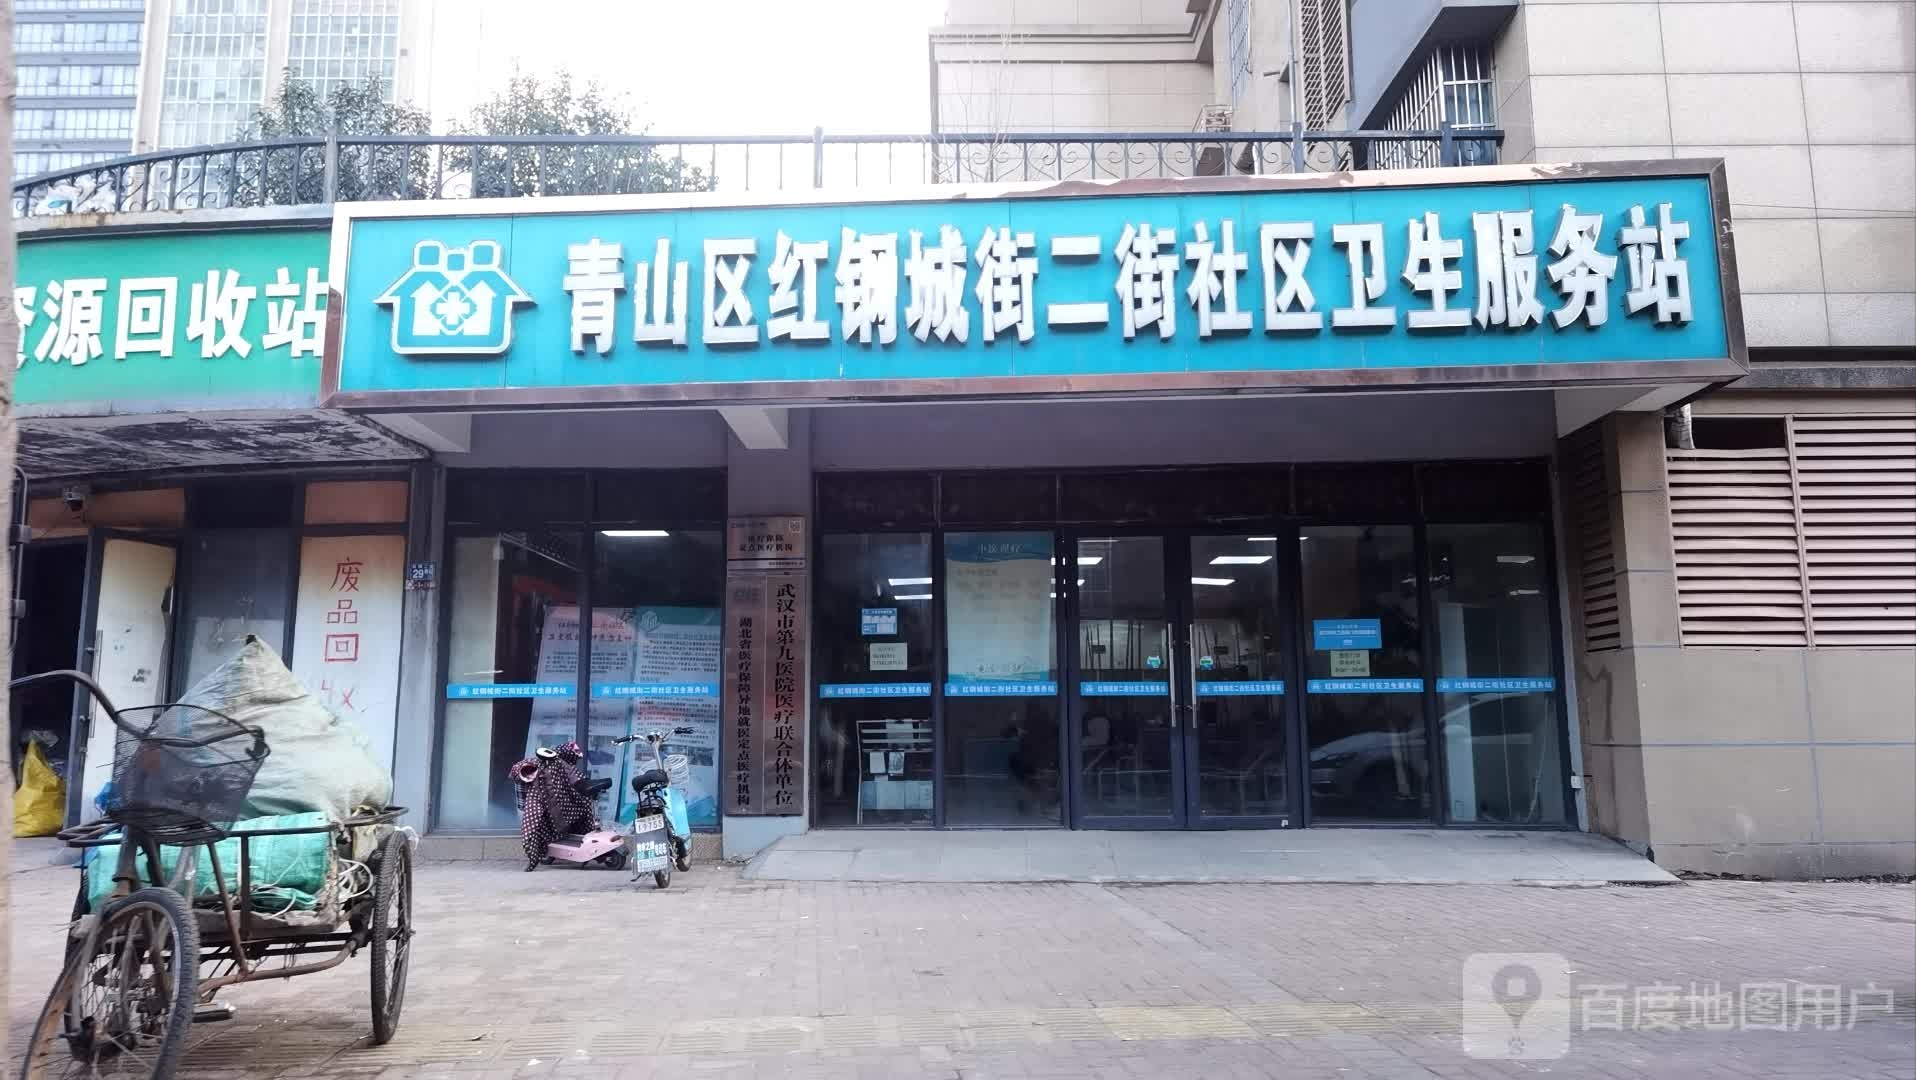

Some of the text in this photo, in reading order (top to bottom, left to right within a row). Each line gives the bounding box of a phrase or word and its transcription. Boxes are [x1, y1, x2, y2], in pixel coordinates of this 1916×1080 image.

[562, 202, 1691, 356] 青山区红钢城街二街社区卫生服务站
[736, 616, 752, 806] 湖北省医疗保障异地就医定点医疗机构
[774, 583, 797, 806] 武汉市第九医院医疗联合体单位
